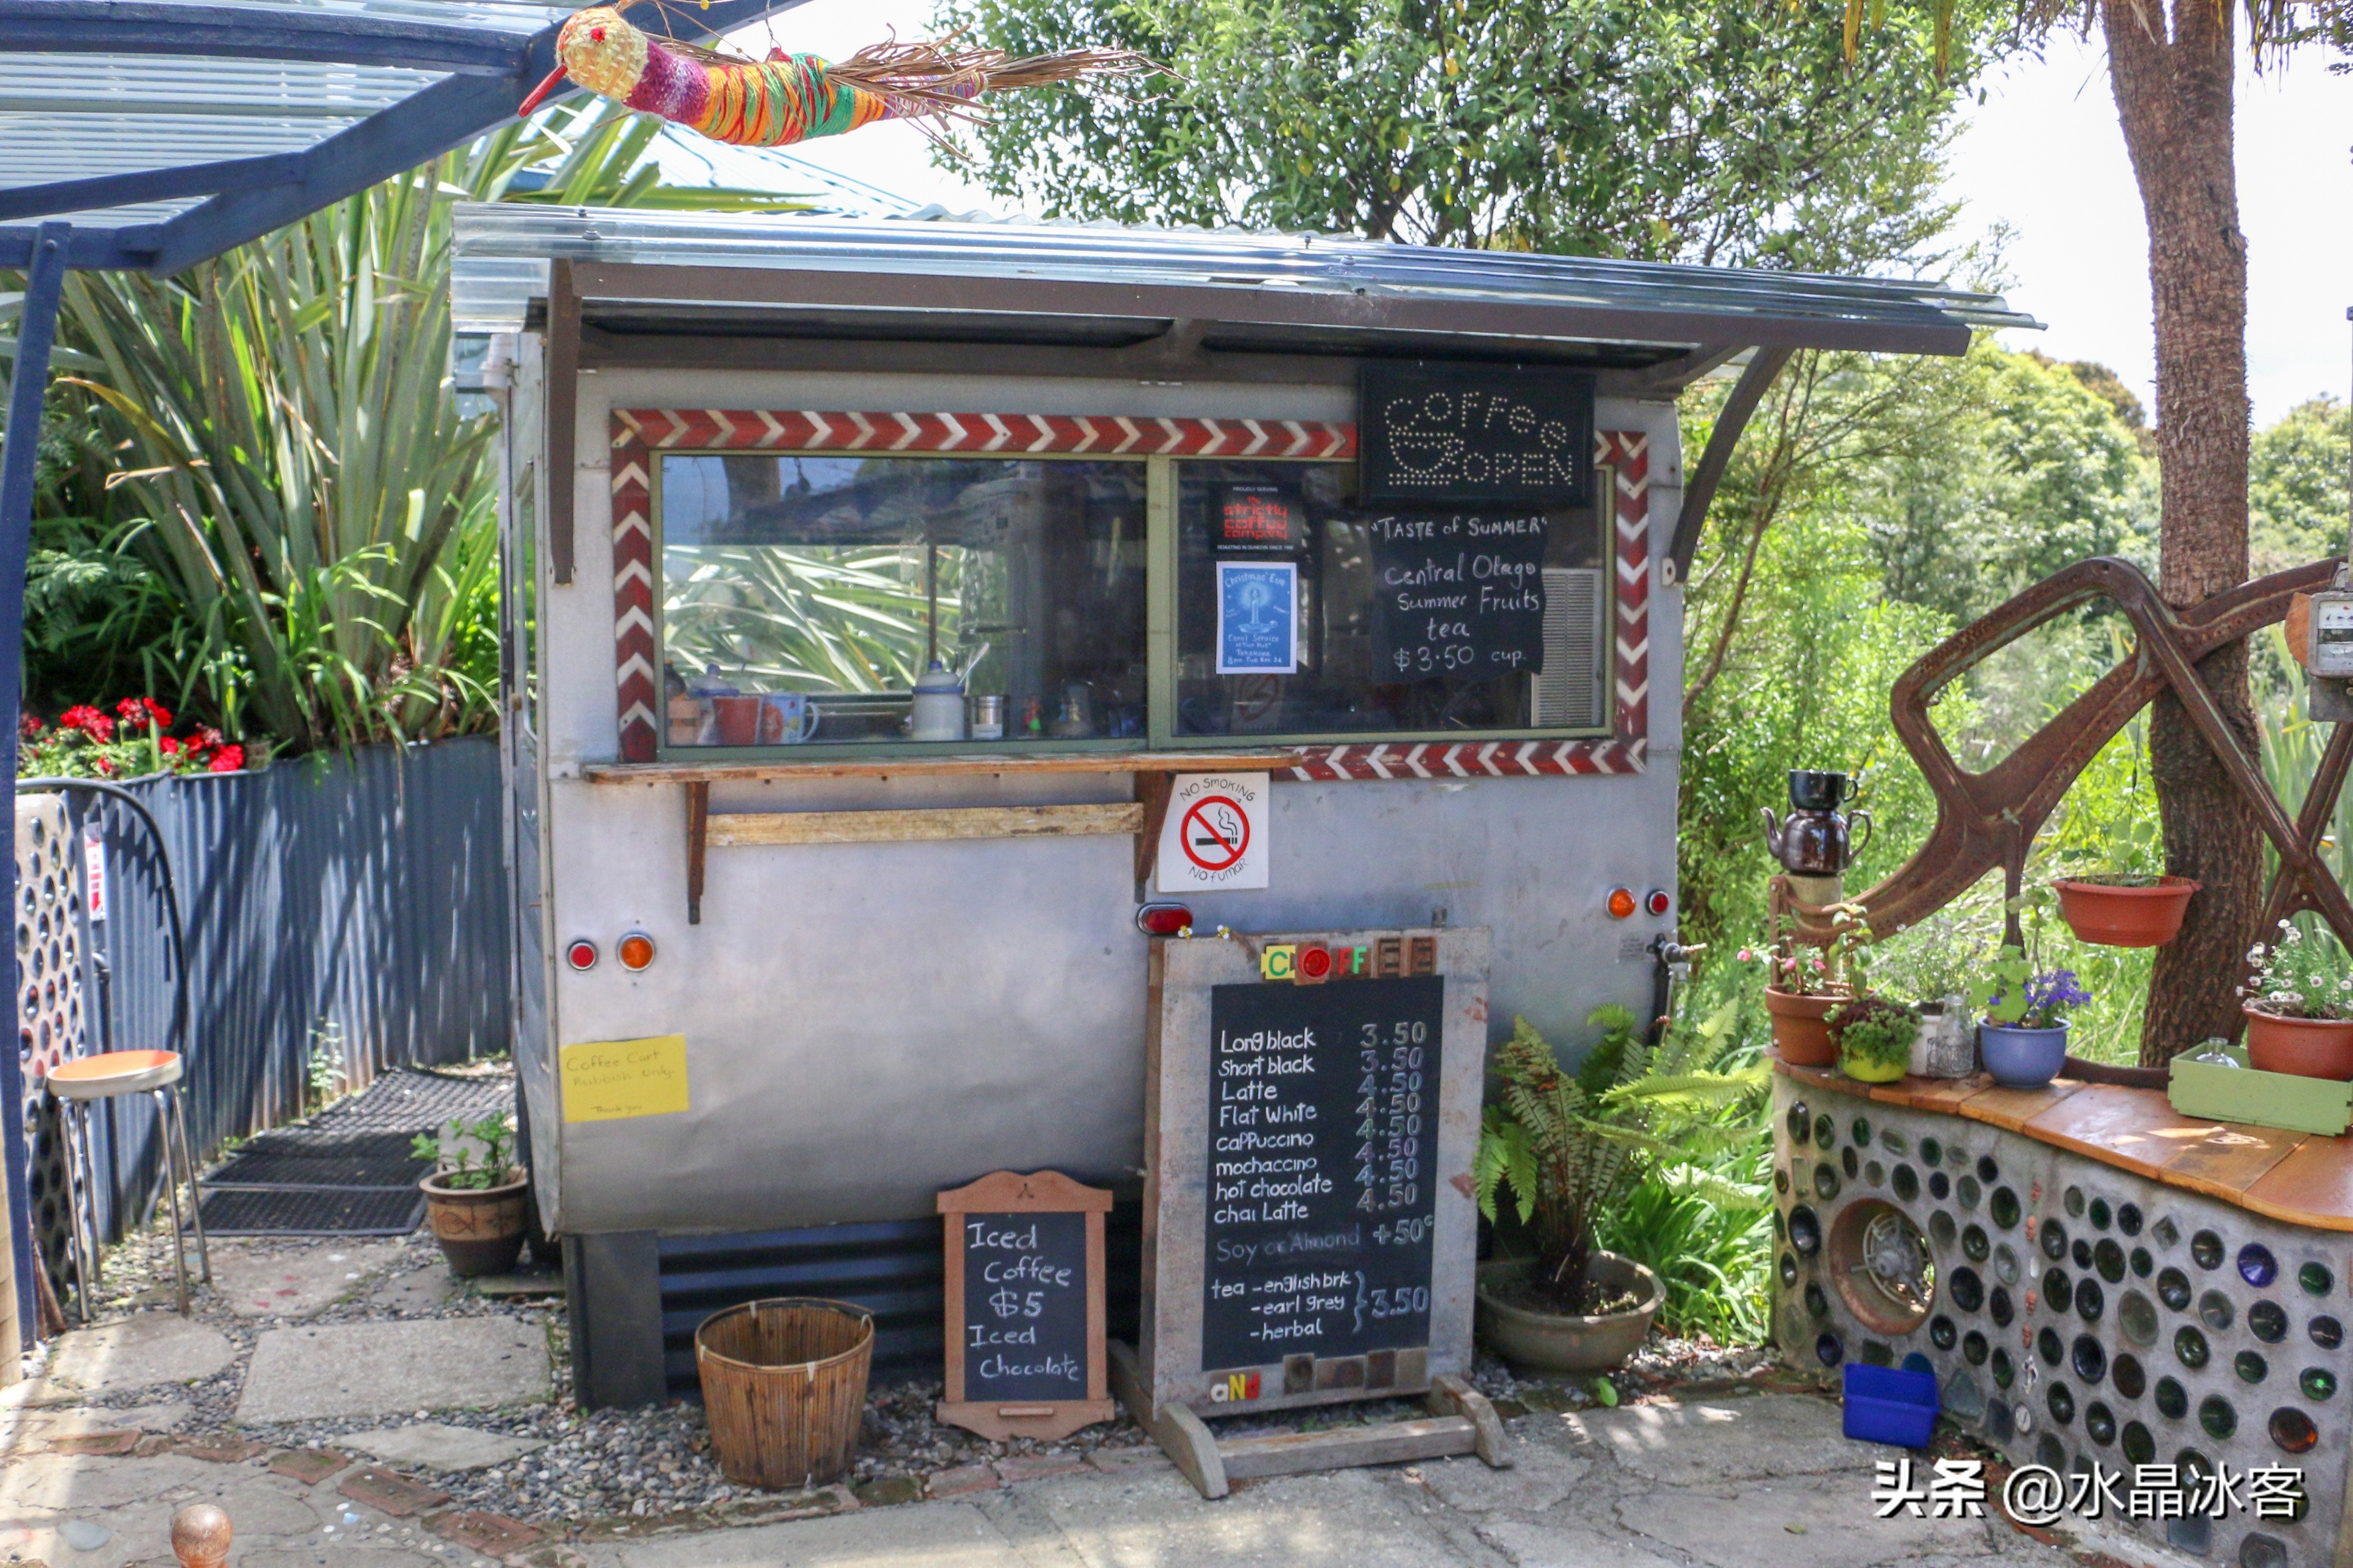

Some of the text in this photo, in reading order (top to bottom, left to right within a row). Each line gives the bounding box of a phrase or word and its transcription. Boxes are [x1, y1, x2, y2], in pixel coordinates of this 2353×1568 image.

[1463, 452, 1572, 485] OPEN
[1443, 516, 1460, 535] of
[1385, 552, 1536, 590] Central Otago
[1479, 586, 1541, 615] Fruits
[1252, 634, 1279, 643] Service
[1427, 617, 1471, 641] tea
[1179, 783, 1199, 802] NO
[1220, 1022, 1427, 1054] Long black 3.50
[566, 1049, 661, 1071] Coffee Cart
[1267, 1054, 1315, 1074] black
[1361, 1047, 1424, 1073] 3.50
[1221, 1072, 1423, 1102] Latte 4.50
[1219, 1093, 1421, 1127] Flat White 4.50
[1356, 1115, 1421, 1139] 4.50
[1355, 1140, 1418, 1160] 4.50
[1215, 1159, 1417, 1203] hot chocolate 4.50
[1214, 1183, 1417, 1225] chai Latte 4.50
[967, 1222, 1037, 1249] Iced
[1216, 1238, 1258, 1265] Soy
[984, 1255, 1072, 1286] Coffee
[1211, 1278, 1245, 1299] tea
[1323, 1270, 1352, 1289] brk
[989, 1286, 1044, 1319] $5
[1306, 1294, 1346, 1312] grey
[1371, 1287, 1430, 1319] 3.50
[968, 1325, 1036, 1348] Iced
[980, 1353, 1080, 1381] Chocolate
